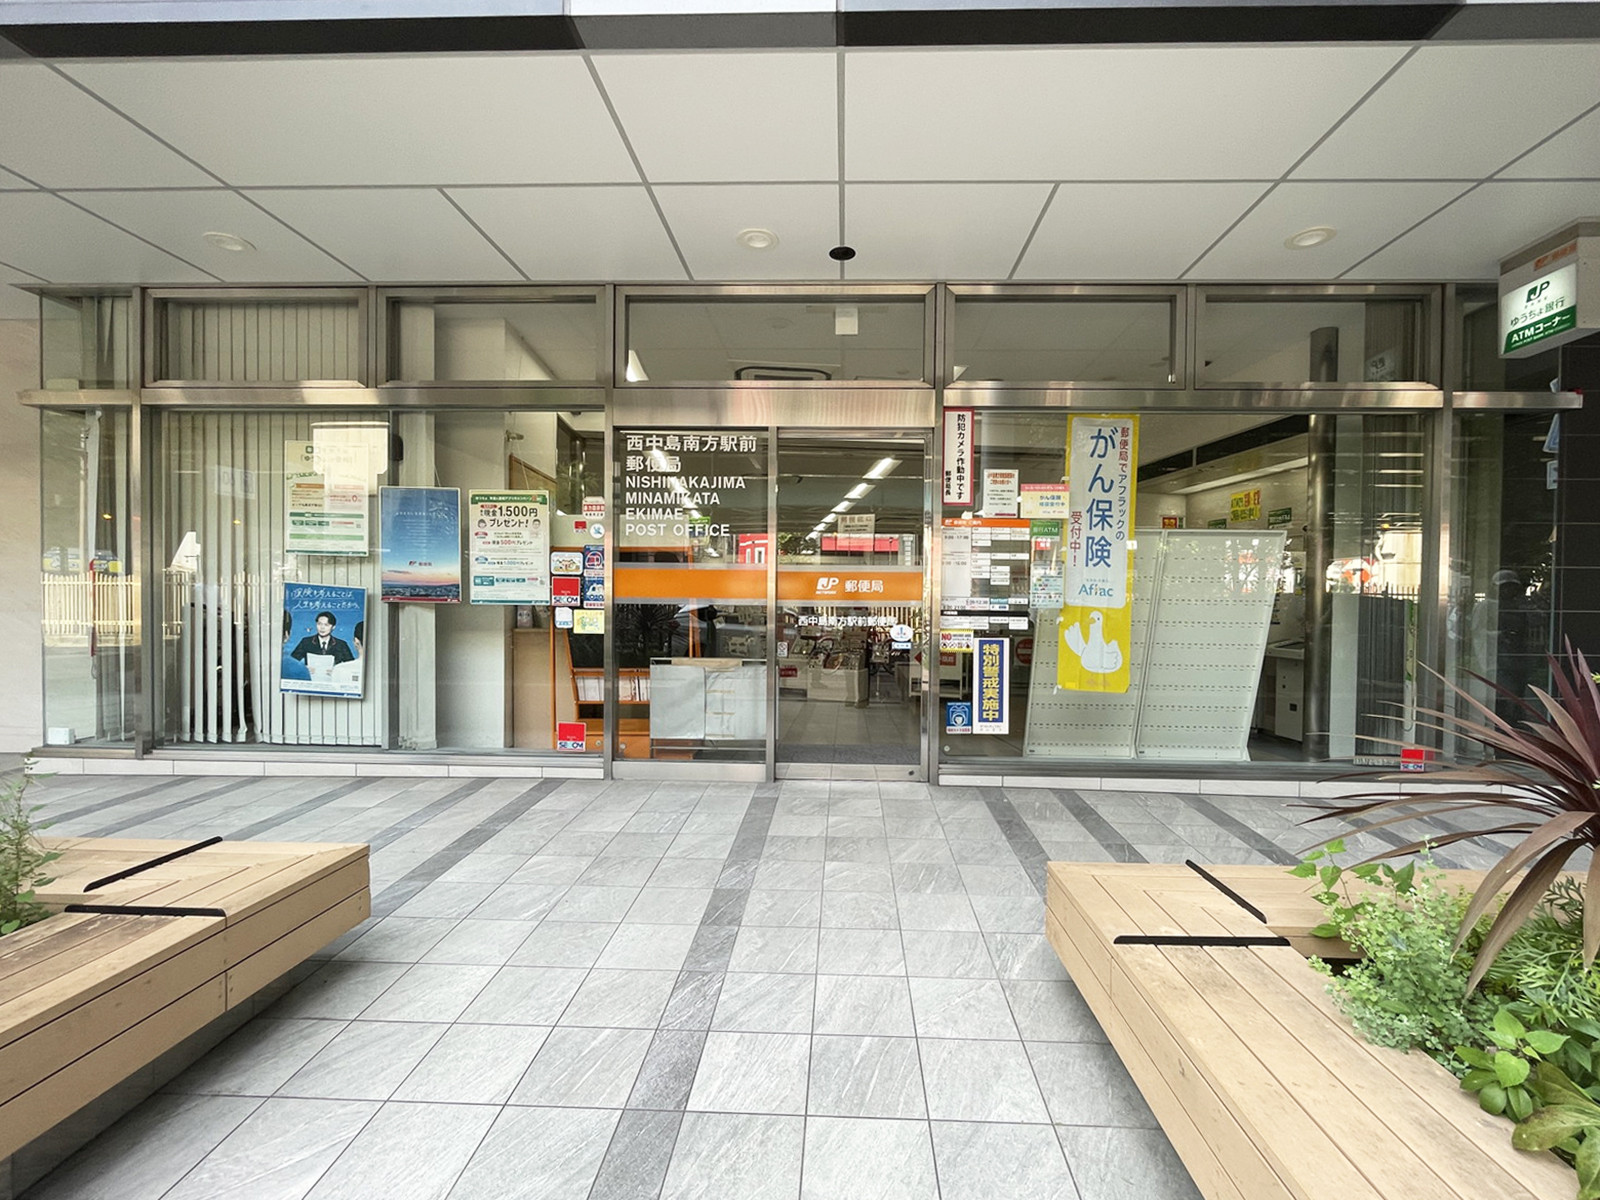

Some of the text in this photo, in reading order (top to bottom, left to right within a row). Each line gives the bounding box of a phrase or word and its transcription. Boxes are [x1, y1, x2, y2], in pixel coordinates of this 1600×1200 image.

[1526, 280, 1550, 303] JP
[1510, 296, 1565, 327] ゆうちょ銀行
[1511, 315, 1571, 343] ATMコーナー
[626, 435, 758, 452] 西中島南方駅前
[626, 455, 682, 473] 郵便局
[956, 413, 966, 500] 防犯カメラ作動中です
[625, 475, 746, 489] NISHINAKAJIMA
[1115, 427, 1130, 541] 郵便局でアフラックの
[625, 491, 721, 505] MINAMIKATA
[1084, 426, 1119, 568] がん保険
[625, 507, 684, 520] EKIMAE
[625, 523, 731, 537] POST OFFICE
[816, 577, 839, 590] JP
[844, 579, 884, 593] 郵便局
[1078, 583, 1114, 597] Aflac
[982, 643, 1000, 721] 特別警戒実施中
